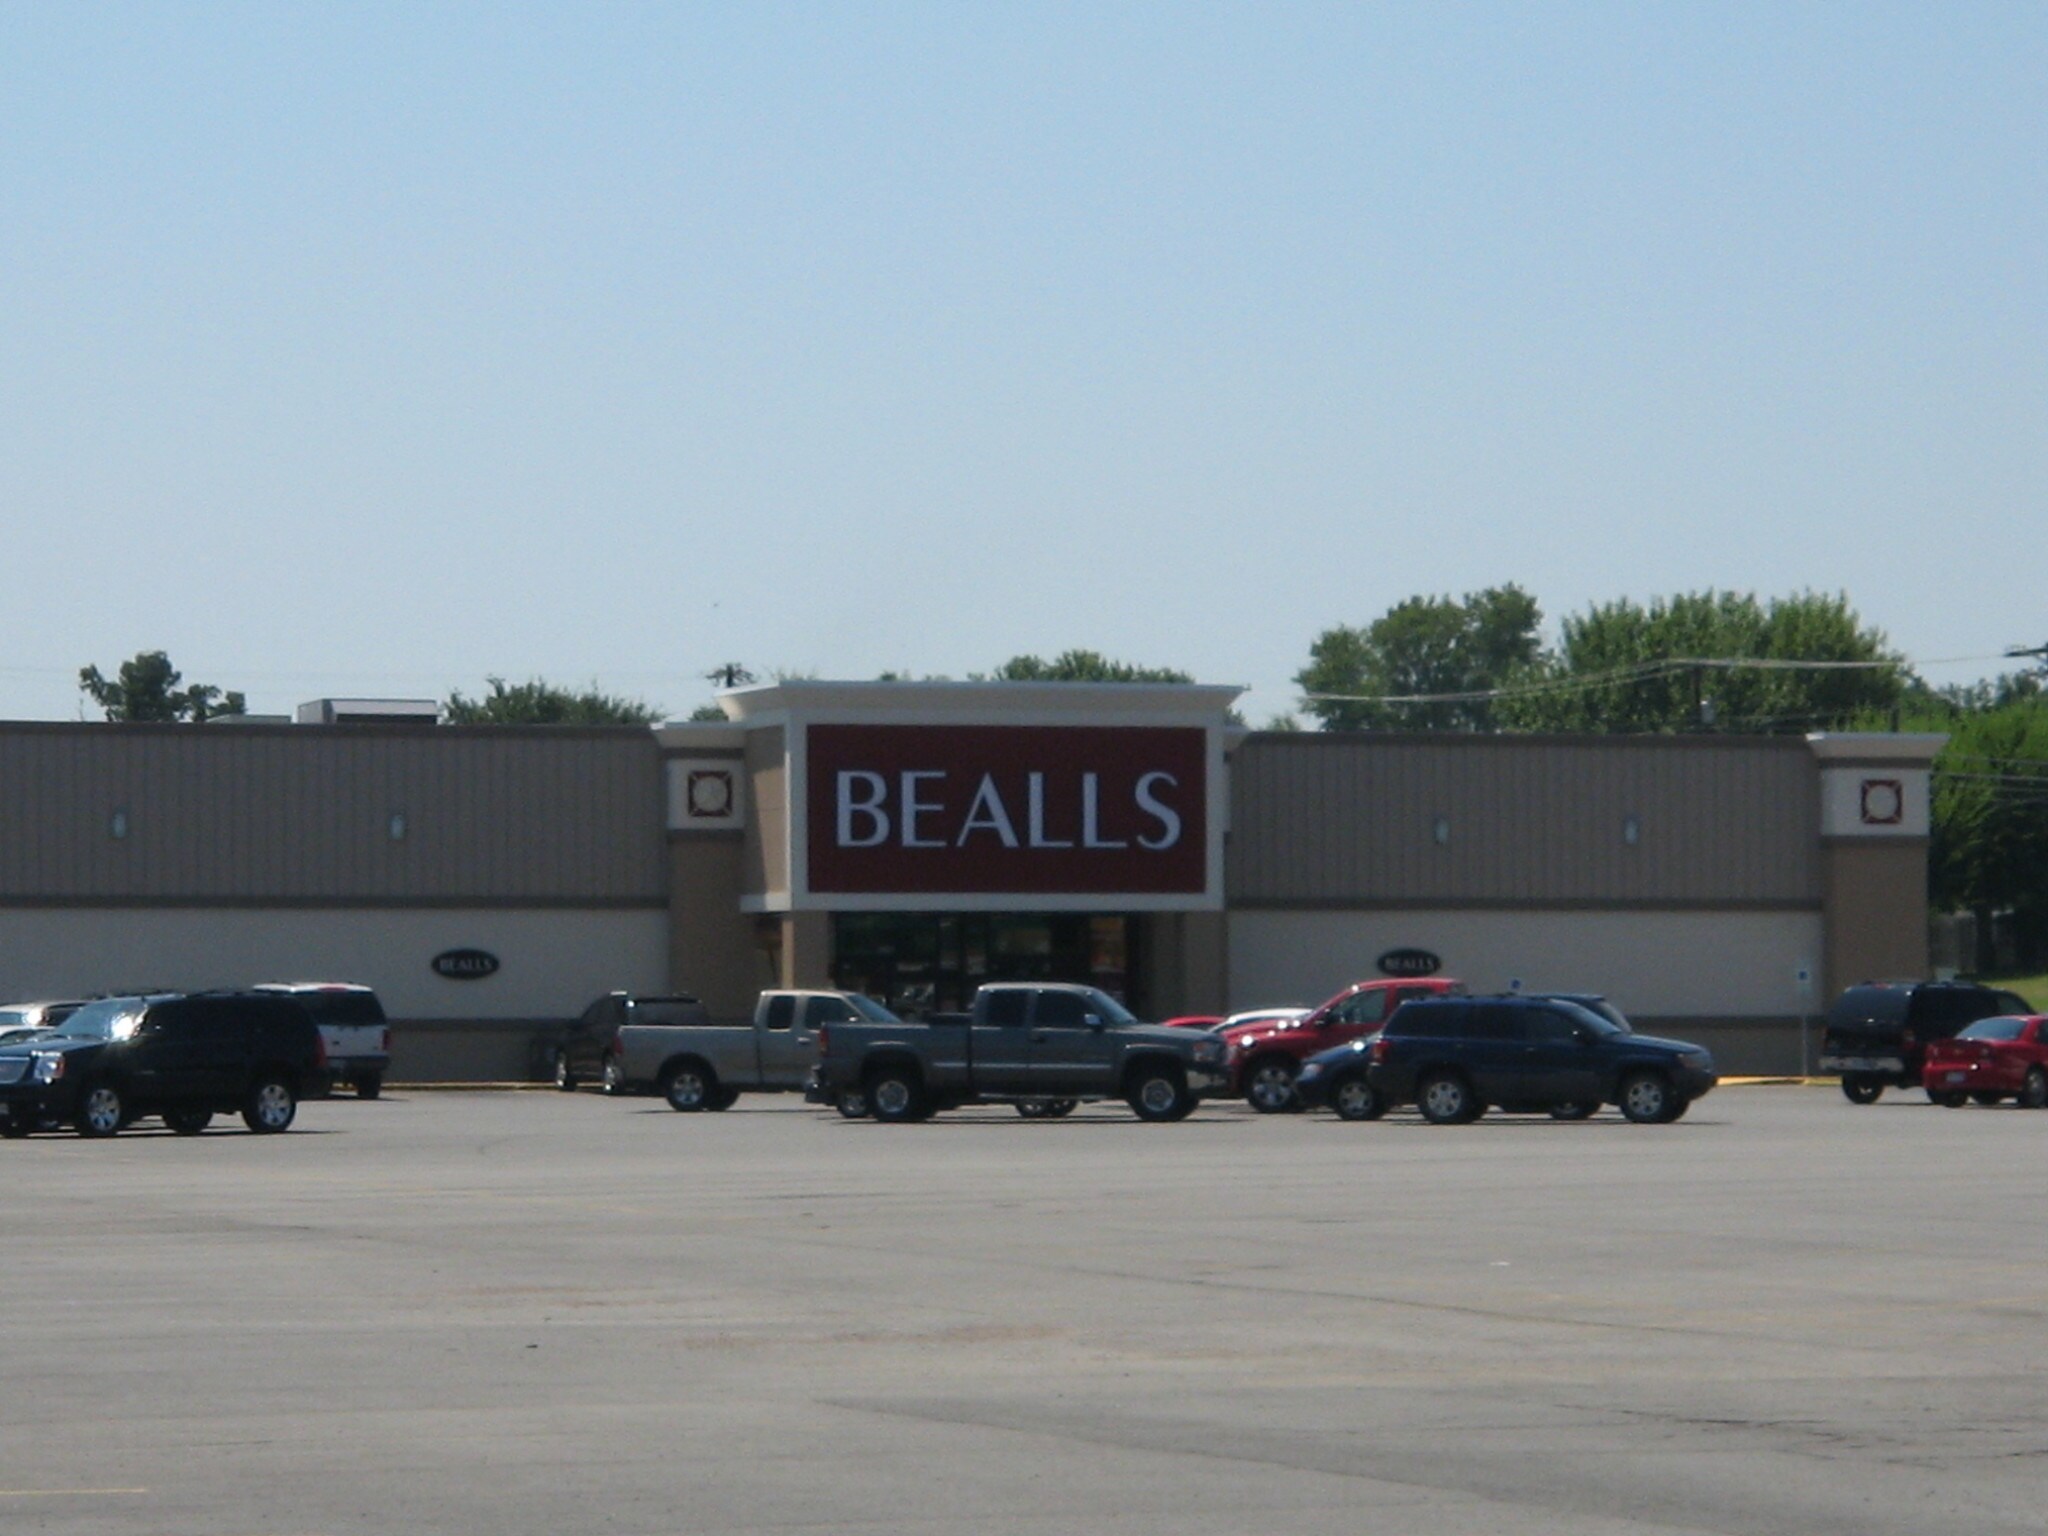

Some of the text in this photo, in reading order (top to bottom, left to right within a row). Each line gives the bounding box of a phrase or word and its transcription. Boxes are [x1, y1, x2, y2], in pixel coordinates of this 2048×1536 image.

[836, 770, 1181, 850] BEALLS
[439, 958, 493, 971] BEALLS
[1384, 957, 1435, 970] BEALLS
